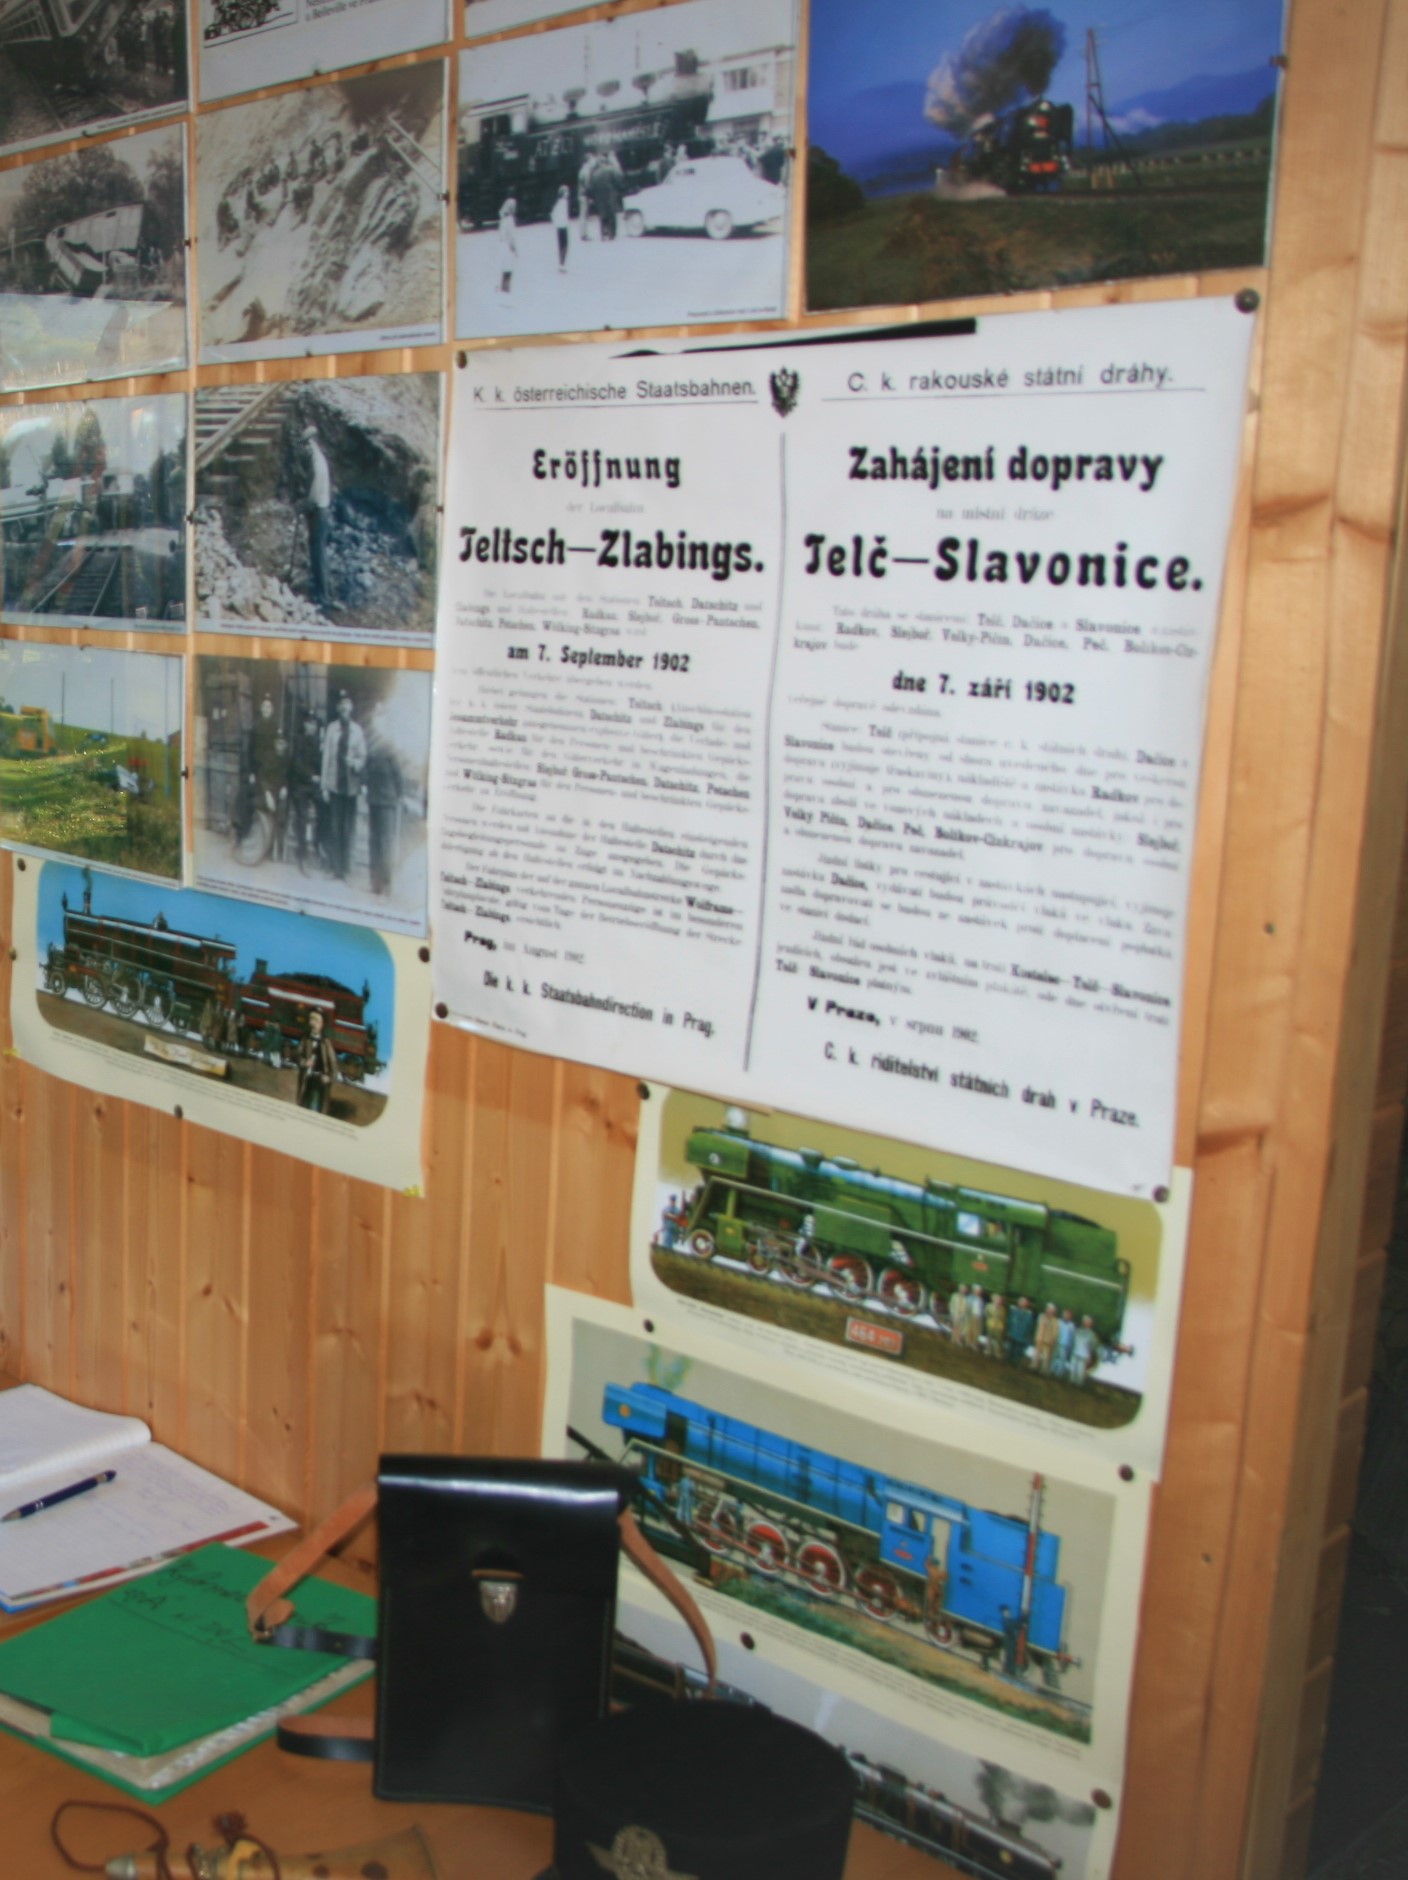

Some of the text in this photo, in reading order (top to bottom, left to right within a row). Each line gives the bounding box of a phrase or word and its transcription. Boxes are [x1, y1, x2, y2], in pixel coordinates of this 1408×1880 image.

[513, 382, 626, 402] österreichische
[636, 378, 756, 399] Staatsbahnen.
[909, 368, 1009, 390] rakouské
[1024, 365, 1083, 387] státní
[1100, 362, 1174, 390] dráhy.
[532, 449, 681, 488] Eröffnung
[848, 445, 1165, 491] Zahájení dopravy
[507, 643, 691, 673] am 7. September 1902
[892, 669, 1076, 703] dne 7. září 1902
[464, 930, 497, 951] Prag,
[662, 1007, 675, 1025] in
[683, 1012, 715, 1038] Prag.
[1021, 1084, 1056, 1110] drah
[1068, 1098, 1078, 1114] v
[1090, 1098, 1140, 1129] Praze.
